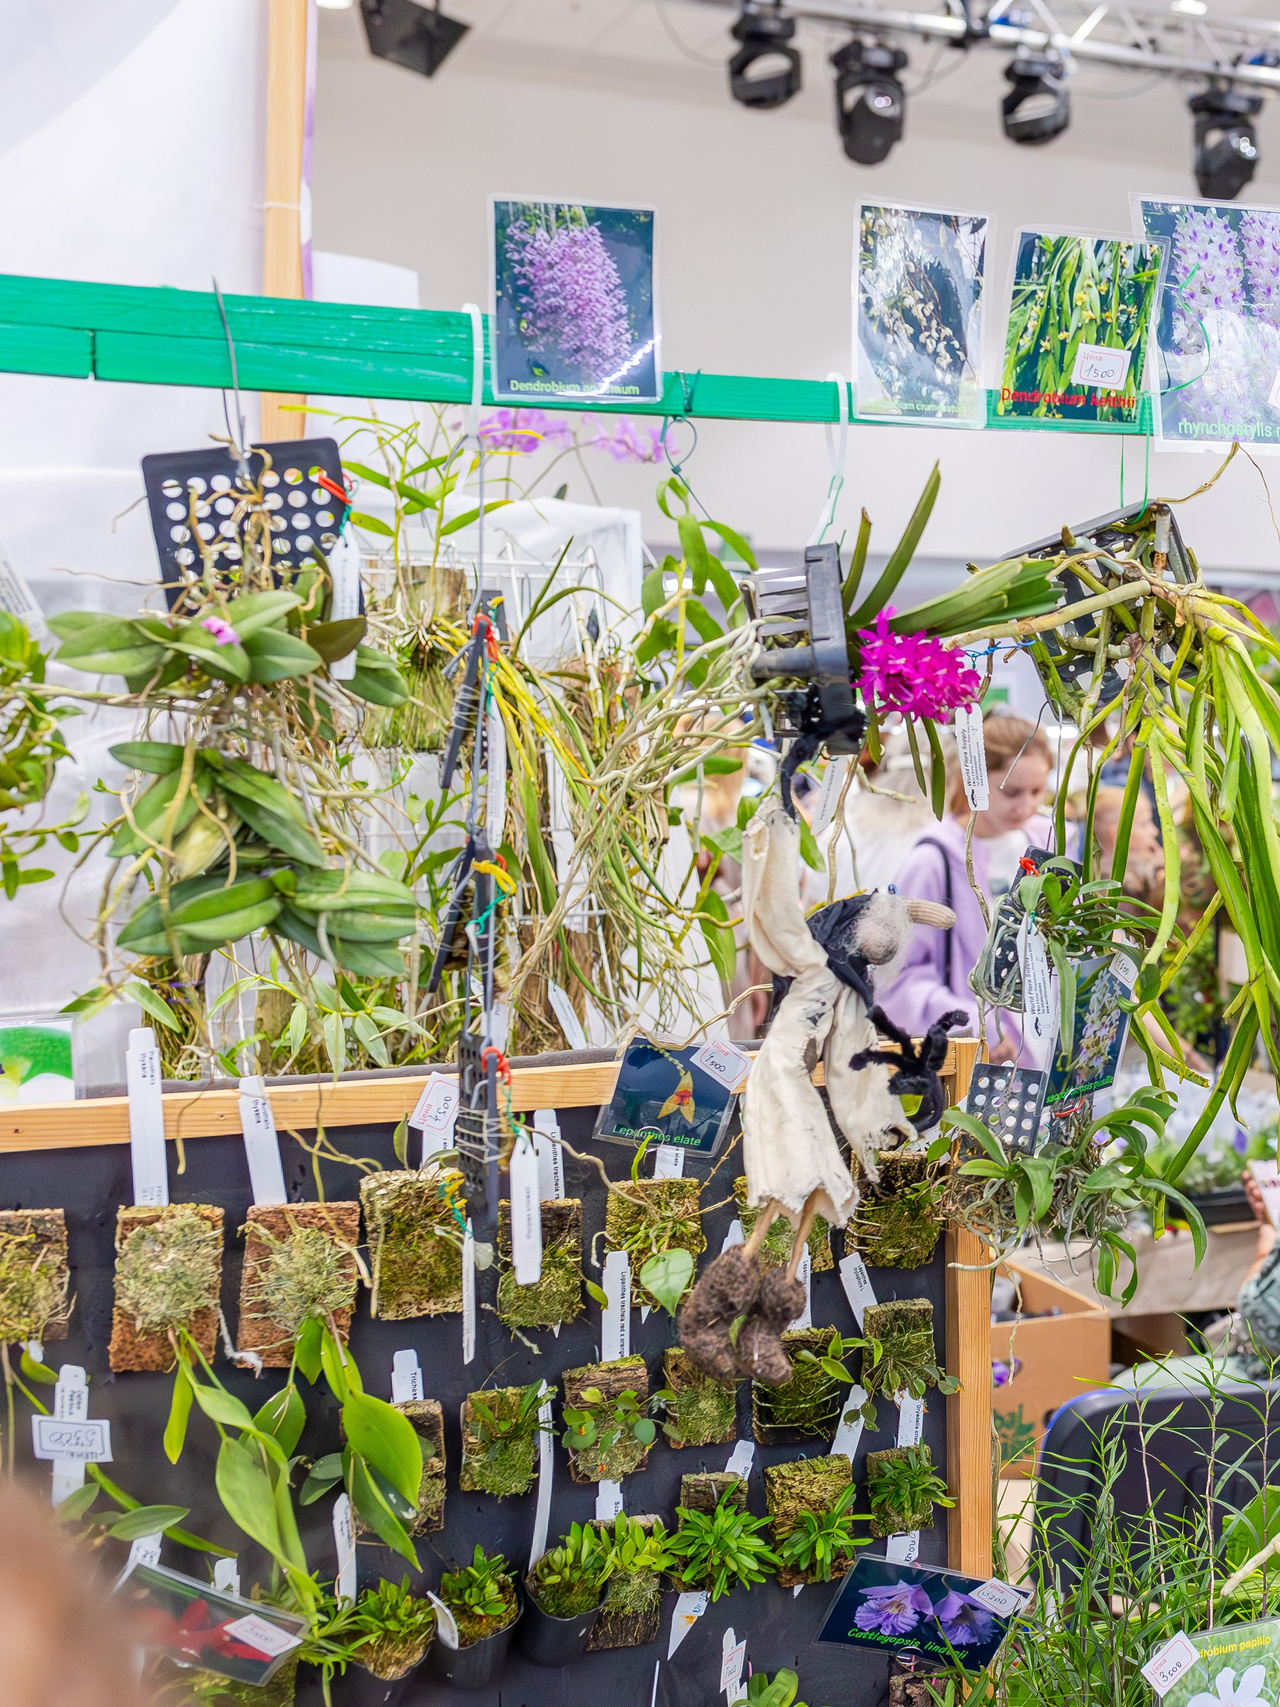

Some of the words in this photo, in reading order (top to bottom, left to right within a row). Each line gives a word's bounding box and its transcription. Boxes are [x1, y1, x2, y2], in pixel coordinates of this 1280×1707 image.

[1085, 364, 1115, 379] 1500
[509, 379, 580, 393] Dendrobium
[1001, 387, 1086, 406] Dendrobium
[1178, 418, 1273, 440] rhynchostylis
[960, 728, 968, 750] Supply
[964, 769, 972, 787] World
[673, 1134, 701, 1146] elate
[847, 1628, 921, 1648] Cattleyopsis
[1239, 1635, 1271, 1652] papilio
